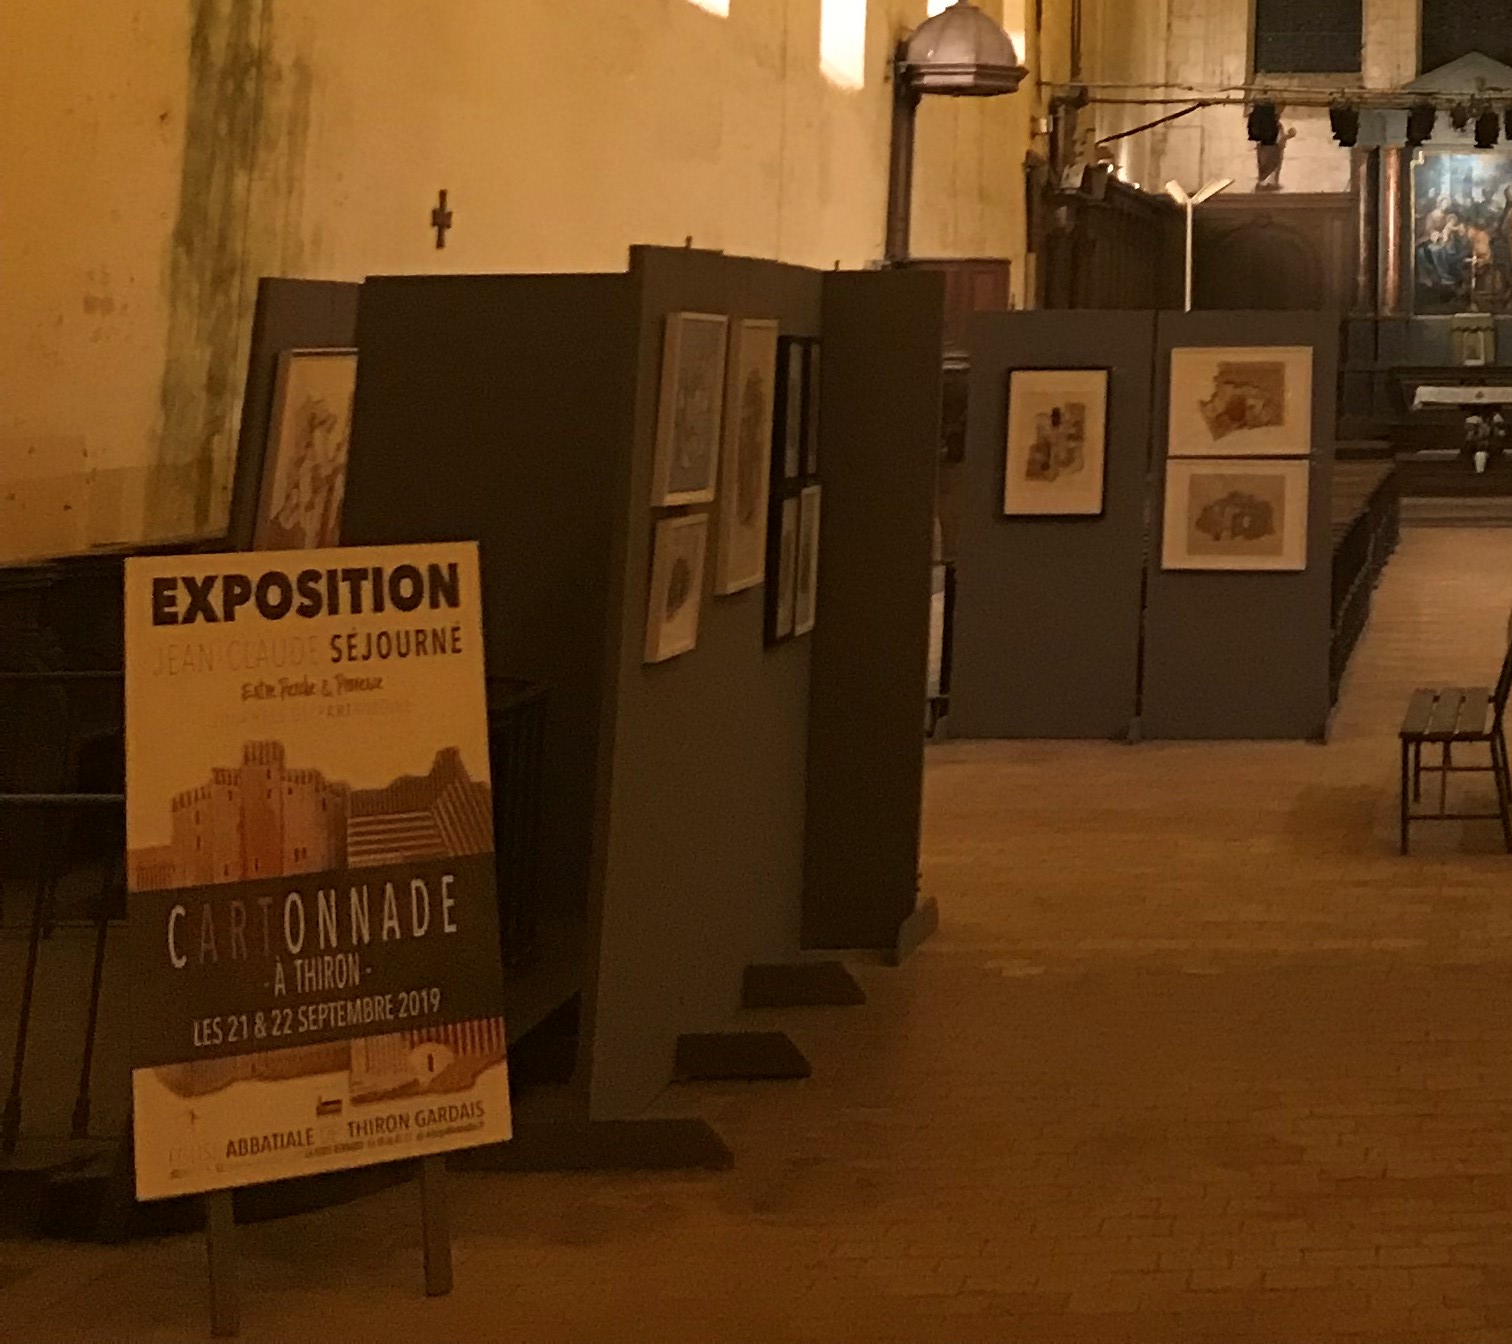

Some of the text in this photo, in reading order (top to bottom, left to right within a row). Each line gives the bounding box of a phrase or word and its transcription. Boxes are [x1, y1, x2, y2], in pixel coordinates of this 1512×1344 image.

[152, 562, 461, 626] EXPOSITION
[329, 621, 463, 664] SÉJOURNÉ
[167, 874, 458, 969] CARTONNADE
[295, 952, 361, 993] THIRON
[193, 987, 441, 1047] LES 21 & 22 SEPTEMBRE 2019
[226, 1127, 315, 1159] ABBATIALE
[347, 1111, 410, 1138] THIRON
[414, 1100, 486, 1128] GARDAIS
